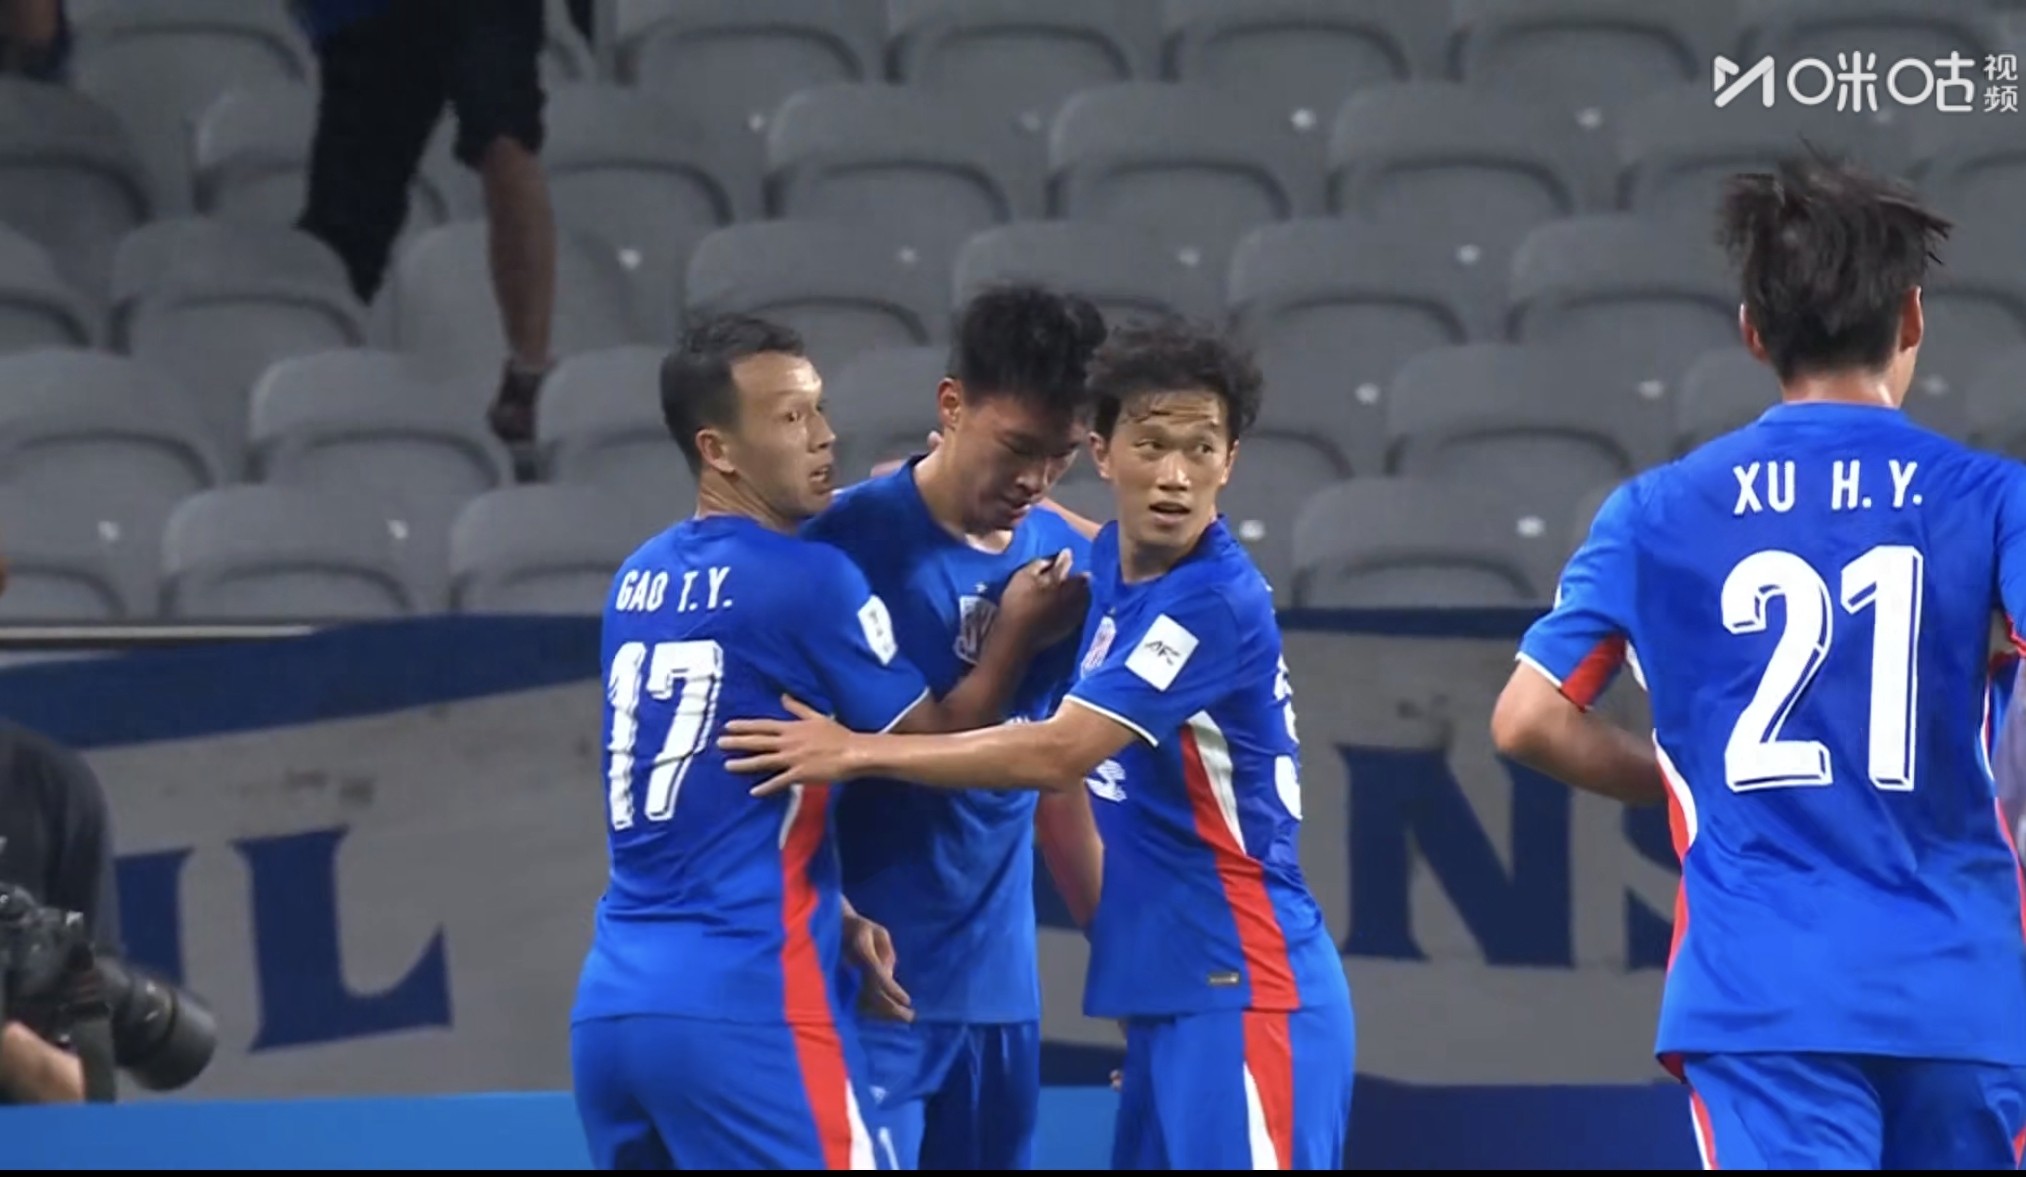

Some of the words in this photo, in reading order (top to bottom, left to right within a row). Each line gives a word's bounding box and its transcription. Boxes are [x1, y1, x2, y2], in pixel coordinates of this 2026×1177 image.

[1732, 460, 1796, 516] XU
[615, 569, 669, 613] GAO
[677, 565, 734, 613] T.Y.
[1720, 545, 1925, 793] 21
[607, 638, 725, 832] 17
